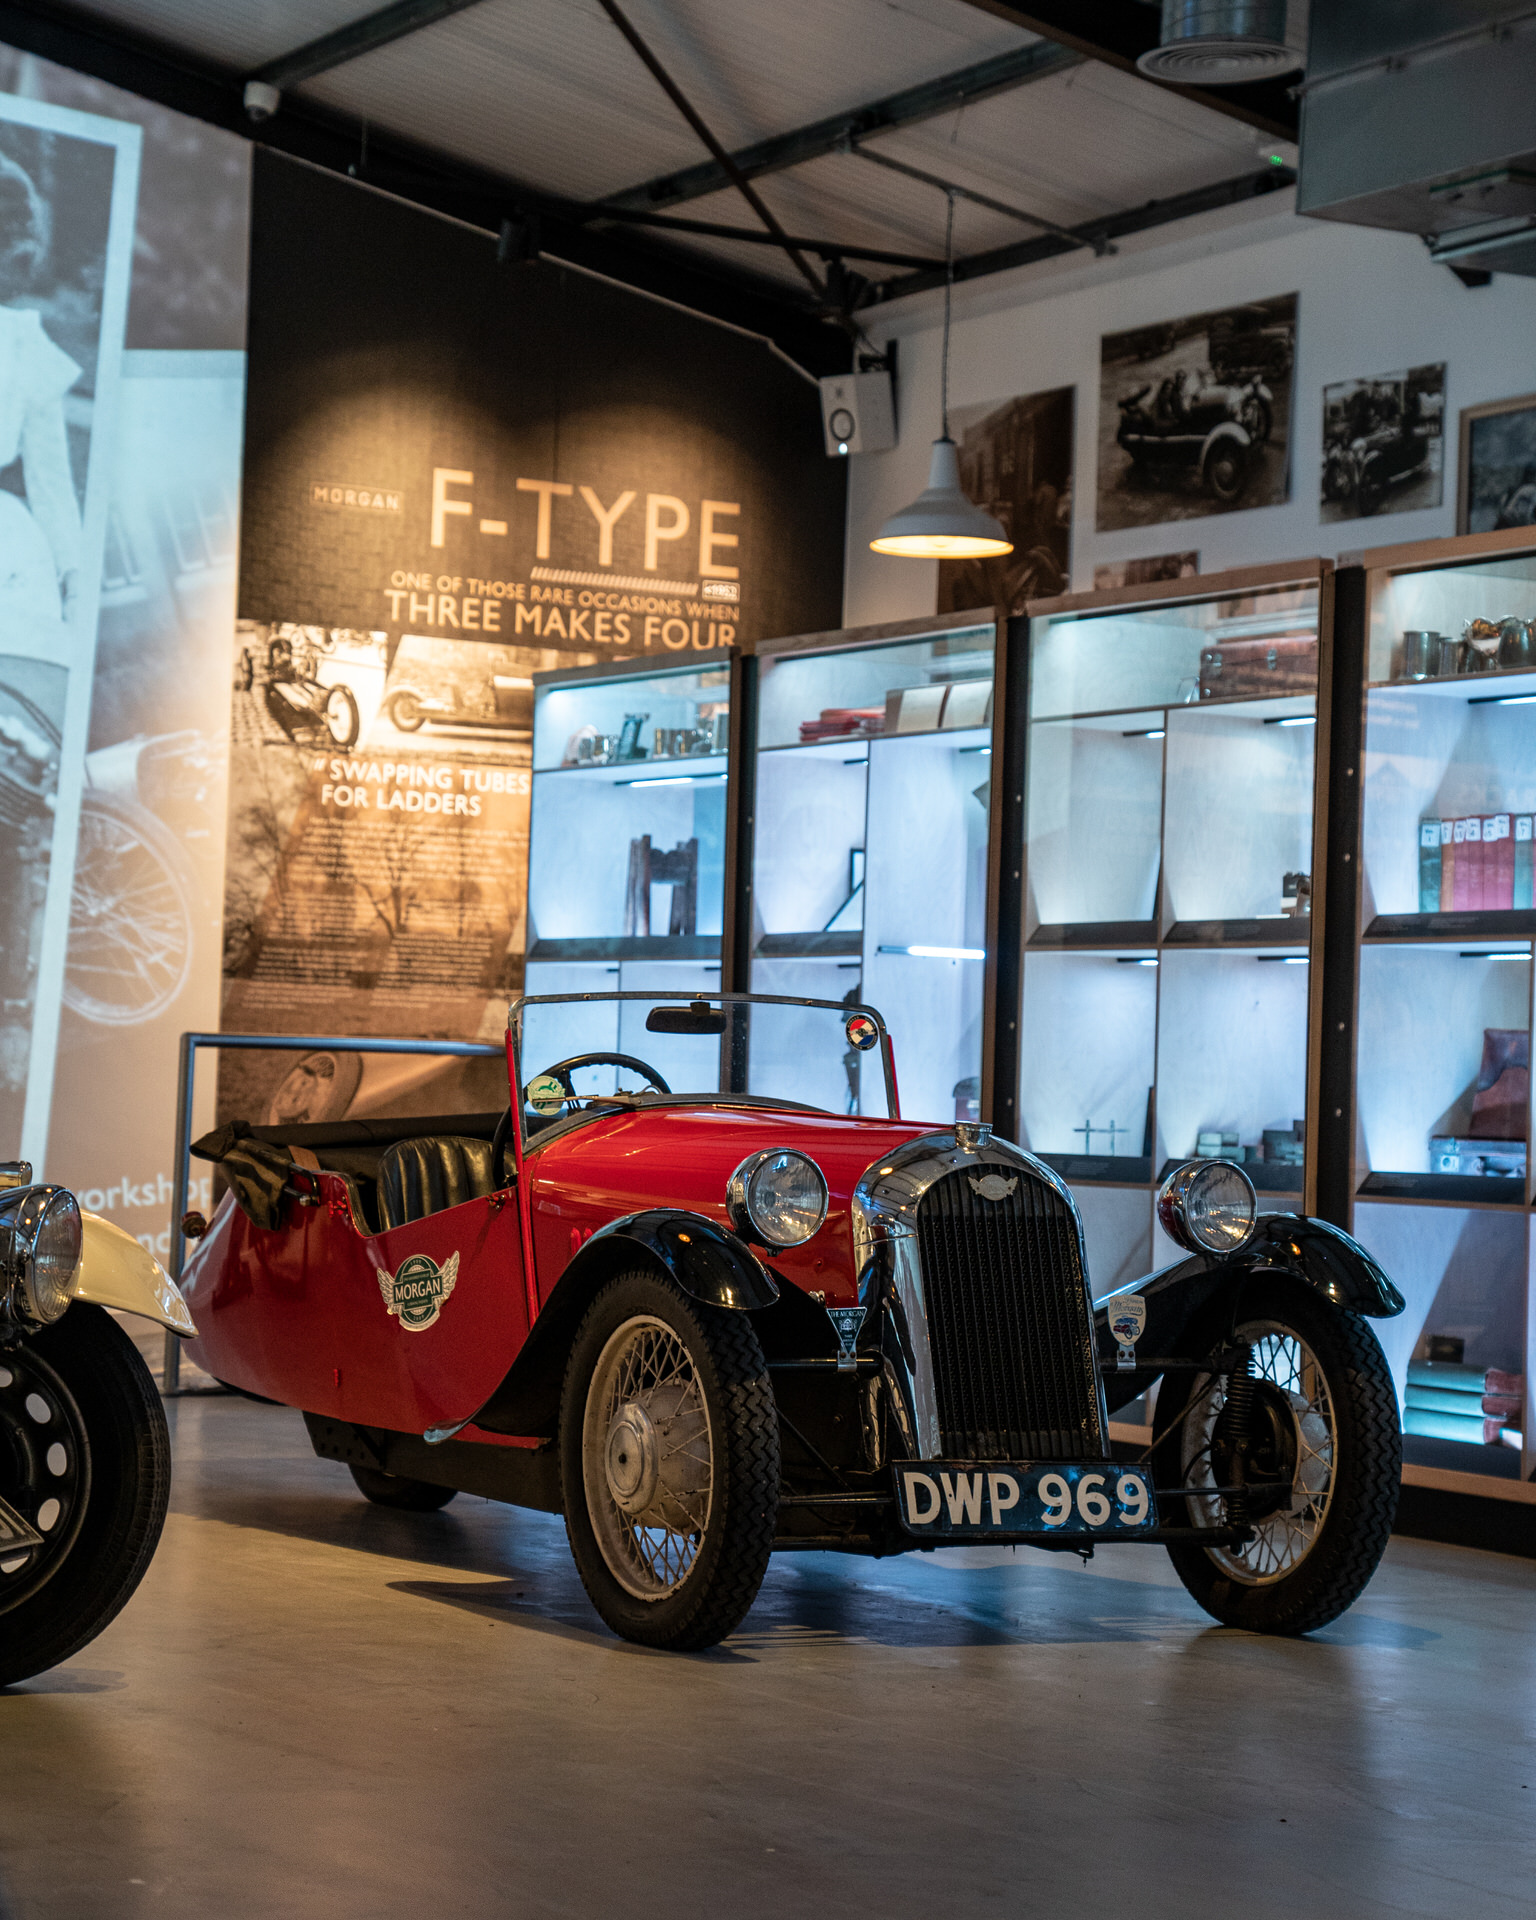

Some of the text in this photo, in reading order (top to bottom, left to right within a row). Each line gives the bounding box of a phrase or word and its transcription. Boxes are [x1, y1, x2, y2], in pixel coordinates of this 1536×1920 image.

[313, 486, 400, 511] MORGAN
[430, 467, 741, 580] F-TYPE
[390, 570, 433, 591] ONE
[436, 575, 463, 593] OF
[466, 577, 526, 600] THOSE
[530, 583, 574, 606] RARE
[577, 590, 683, 616] OCCASIONS
[684, 601, 740, 622] WHEN
[383, 588, 737, 650] THREE MAKES FOUR
[321, 783, 482, 817] FOR LADDERS
[459, 768, 530, 795] TUBES
[395, 1278, 440, 1302] MORGAN
[903, 1472, 1149, 1526] DWP 969
